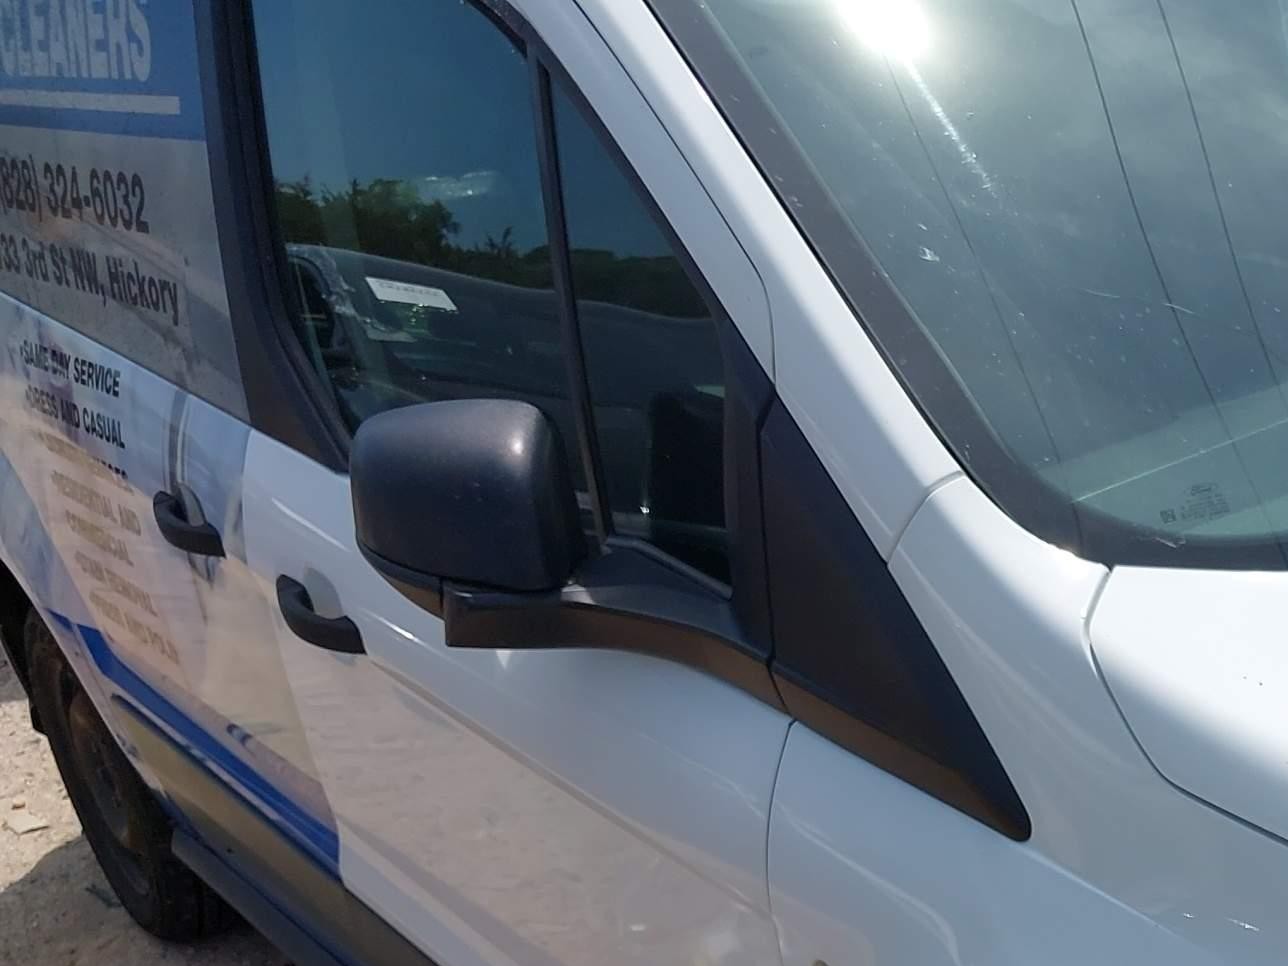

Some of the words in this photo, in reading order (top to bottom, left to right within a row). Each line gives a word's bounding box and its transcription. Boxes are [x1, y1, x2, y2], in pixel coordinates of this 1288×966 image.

[0, 0, 152, 82] CLEANERS
[43, 161, 150, 234] 324-6032
[22, 237, 50, 282] 3rd
[49, 243, 71, 287] St
[69, 247, 107, 307] NW,
[106, 255, 179, 327] Hickory
[73, 357, 121, 398] SERVICE
[82, 407, 126, 449] CASUAL
